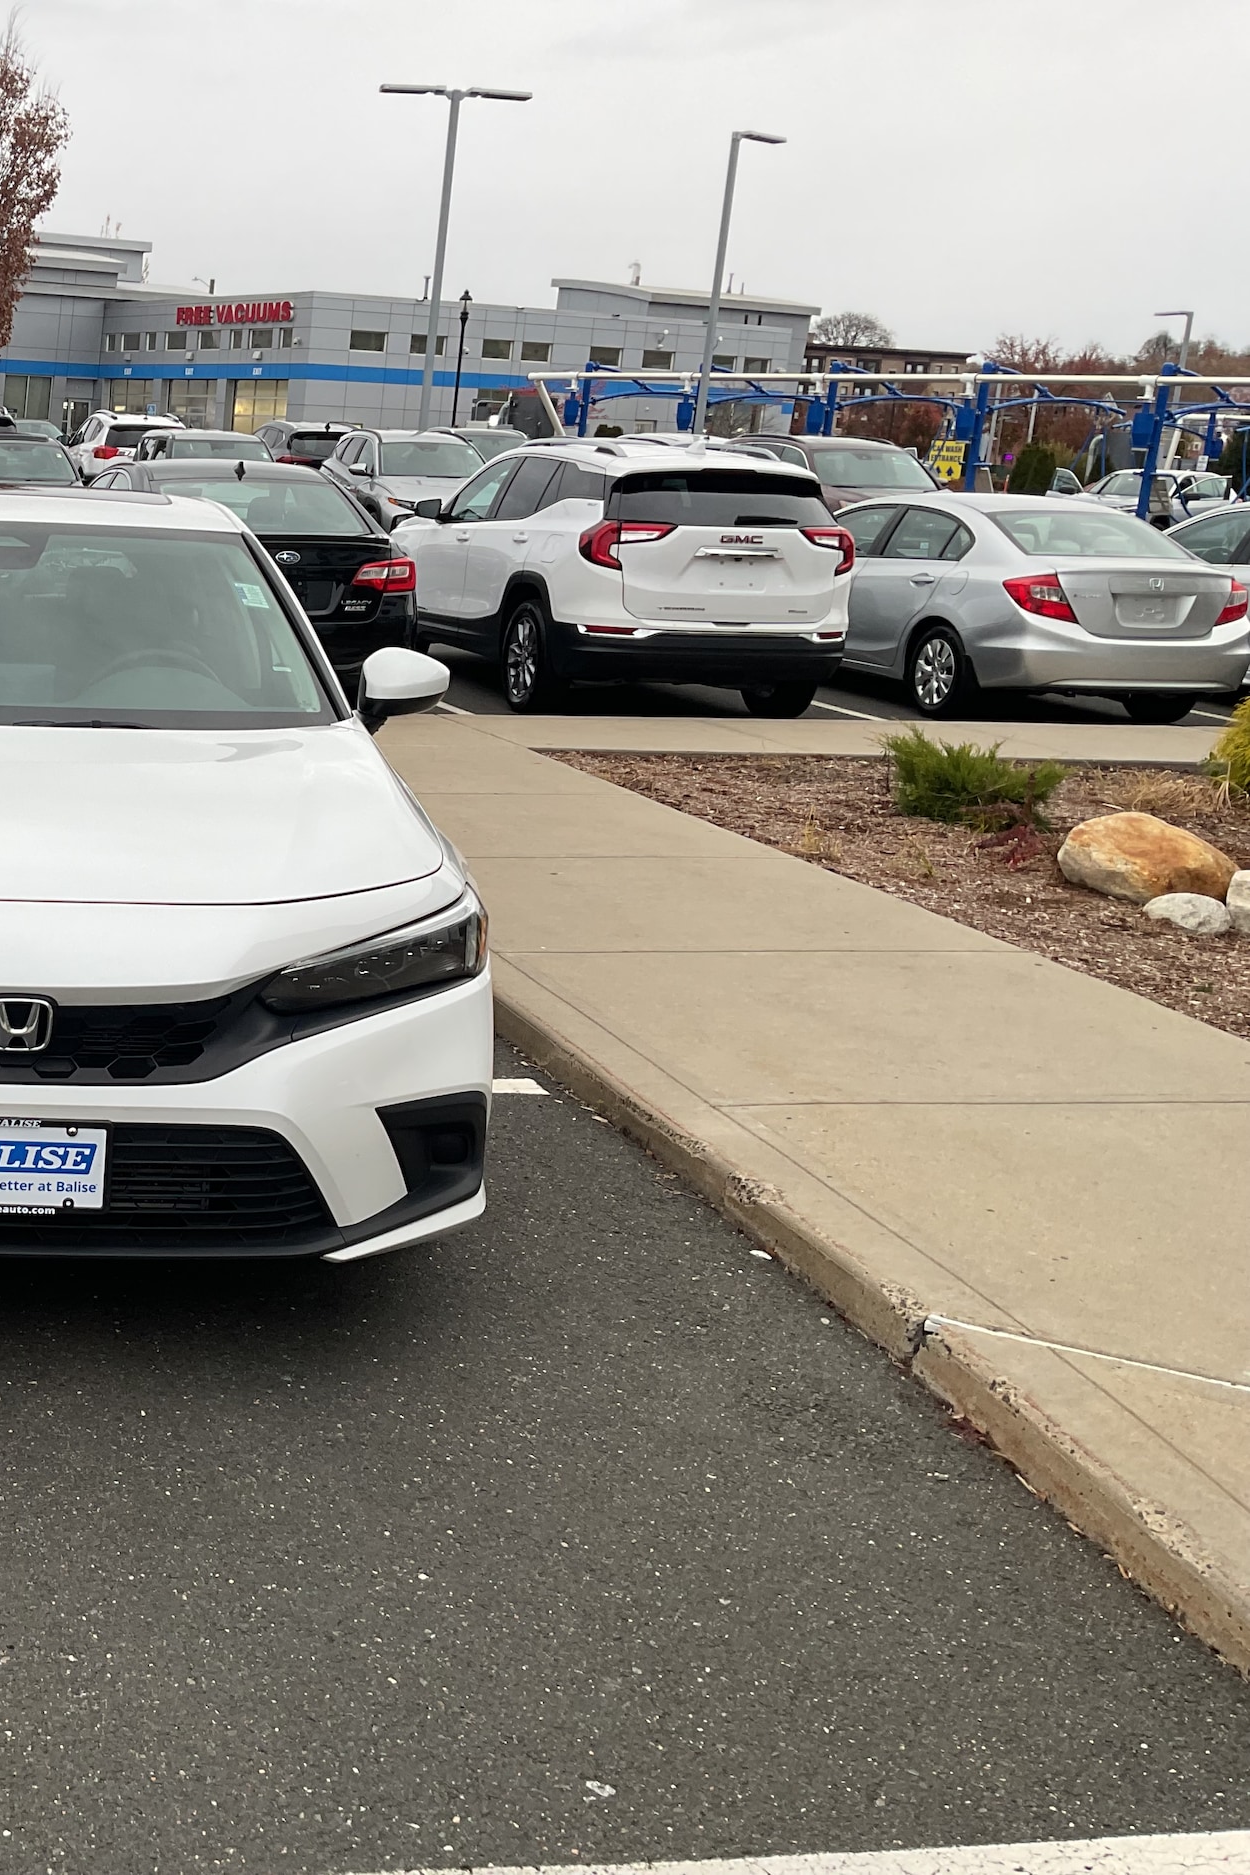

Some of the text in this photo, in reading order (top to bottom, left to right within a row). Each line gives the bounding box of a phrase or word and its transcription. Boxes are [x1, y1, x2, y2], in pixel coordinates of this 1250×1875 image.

[176, 301, 294, 326] FREE VACUUMS
[719, 535, 764, 544] GMC
[37, 1182, 52, 1192] at
[56, 1181, 97, 1193] Balise
